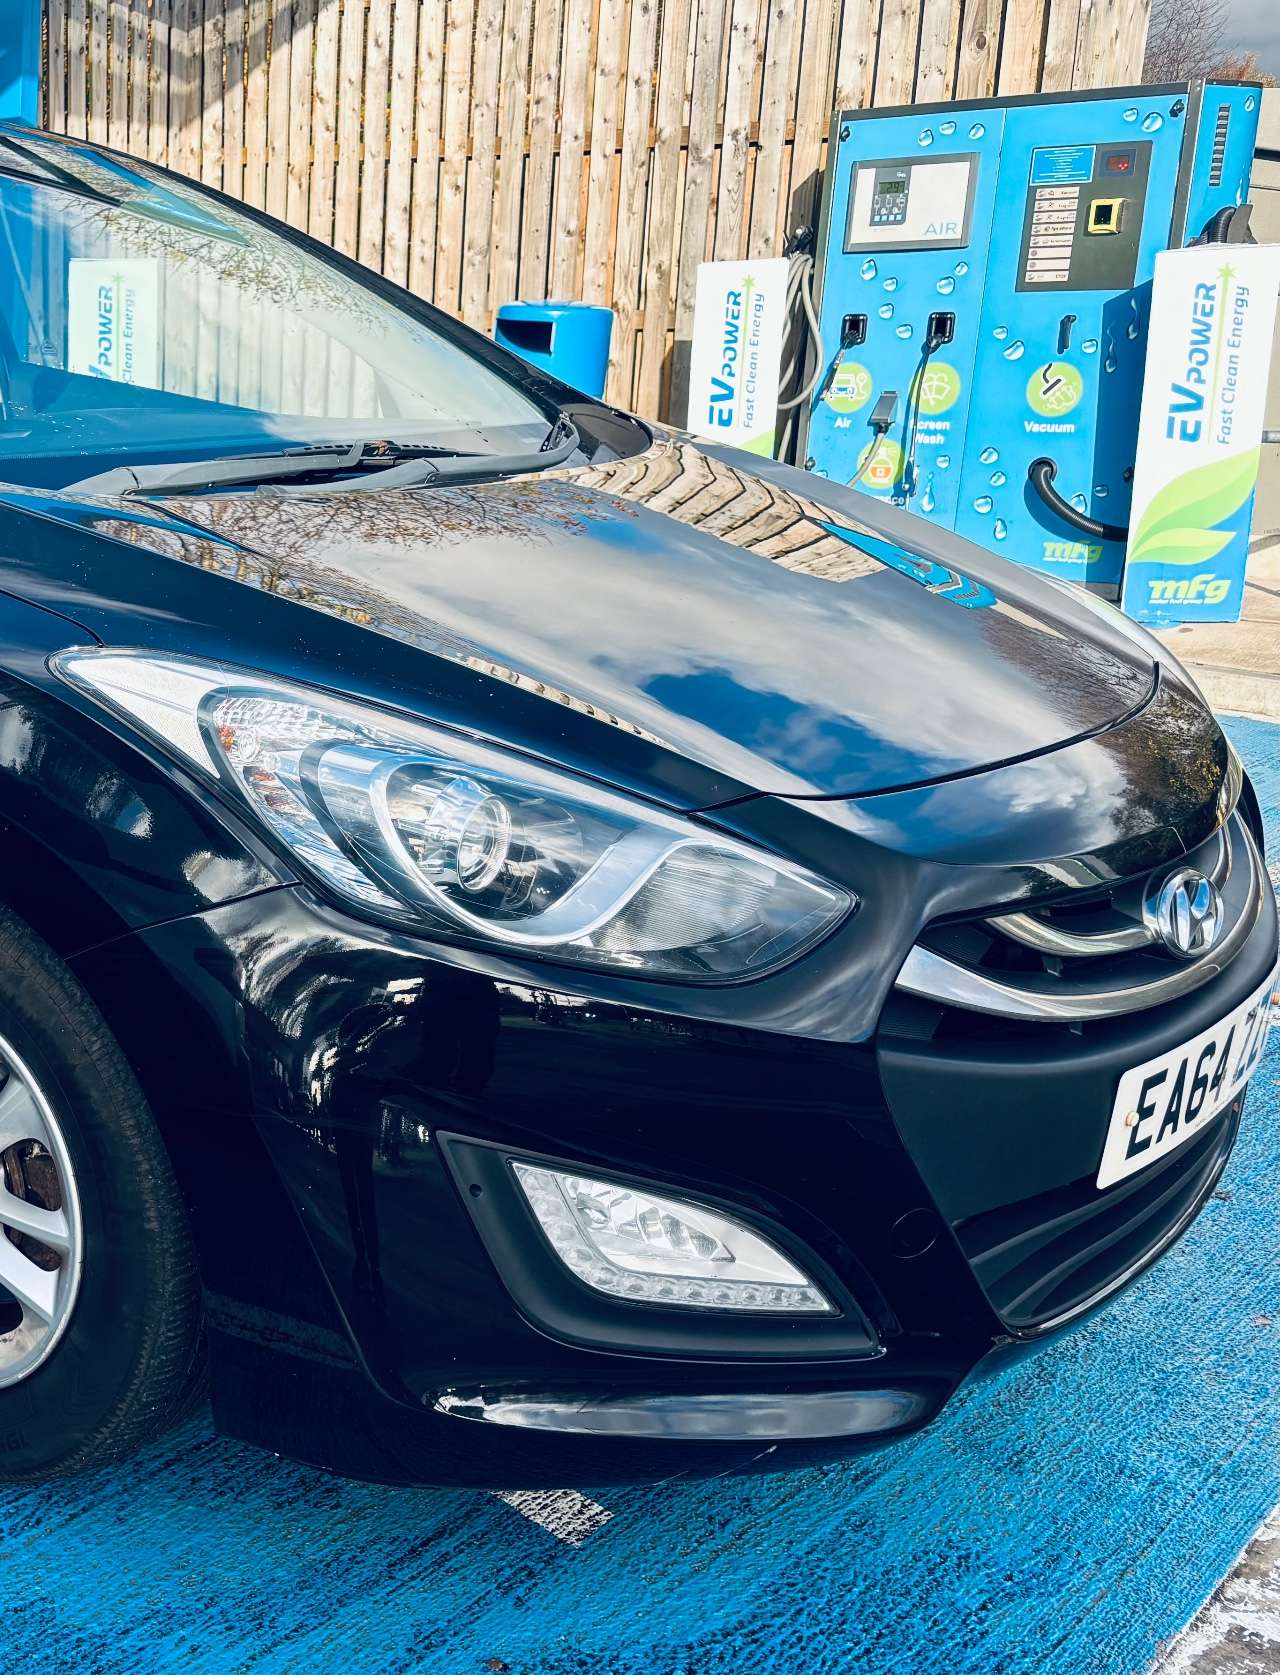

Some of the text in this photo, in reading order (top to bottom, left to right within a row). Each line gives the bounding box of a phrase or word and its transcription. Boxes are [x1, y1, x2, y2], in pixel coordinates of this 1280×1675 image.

[923, 222, 959, 236] AIR
[743, 292, 765, 429] Fast Clean Energy
[1216, 285, 1250, 446] Fast Clean Energy
[834, 418, 853, 428] Air
[1024, 421, 1075, 433] Vacuum
[1148, 573, 1232, 605] mfg
[1125, 1024, 1237, 1161] EA64
